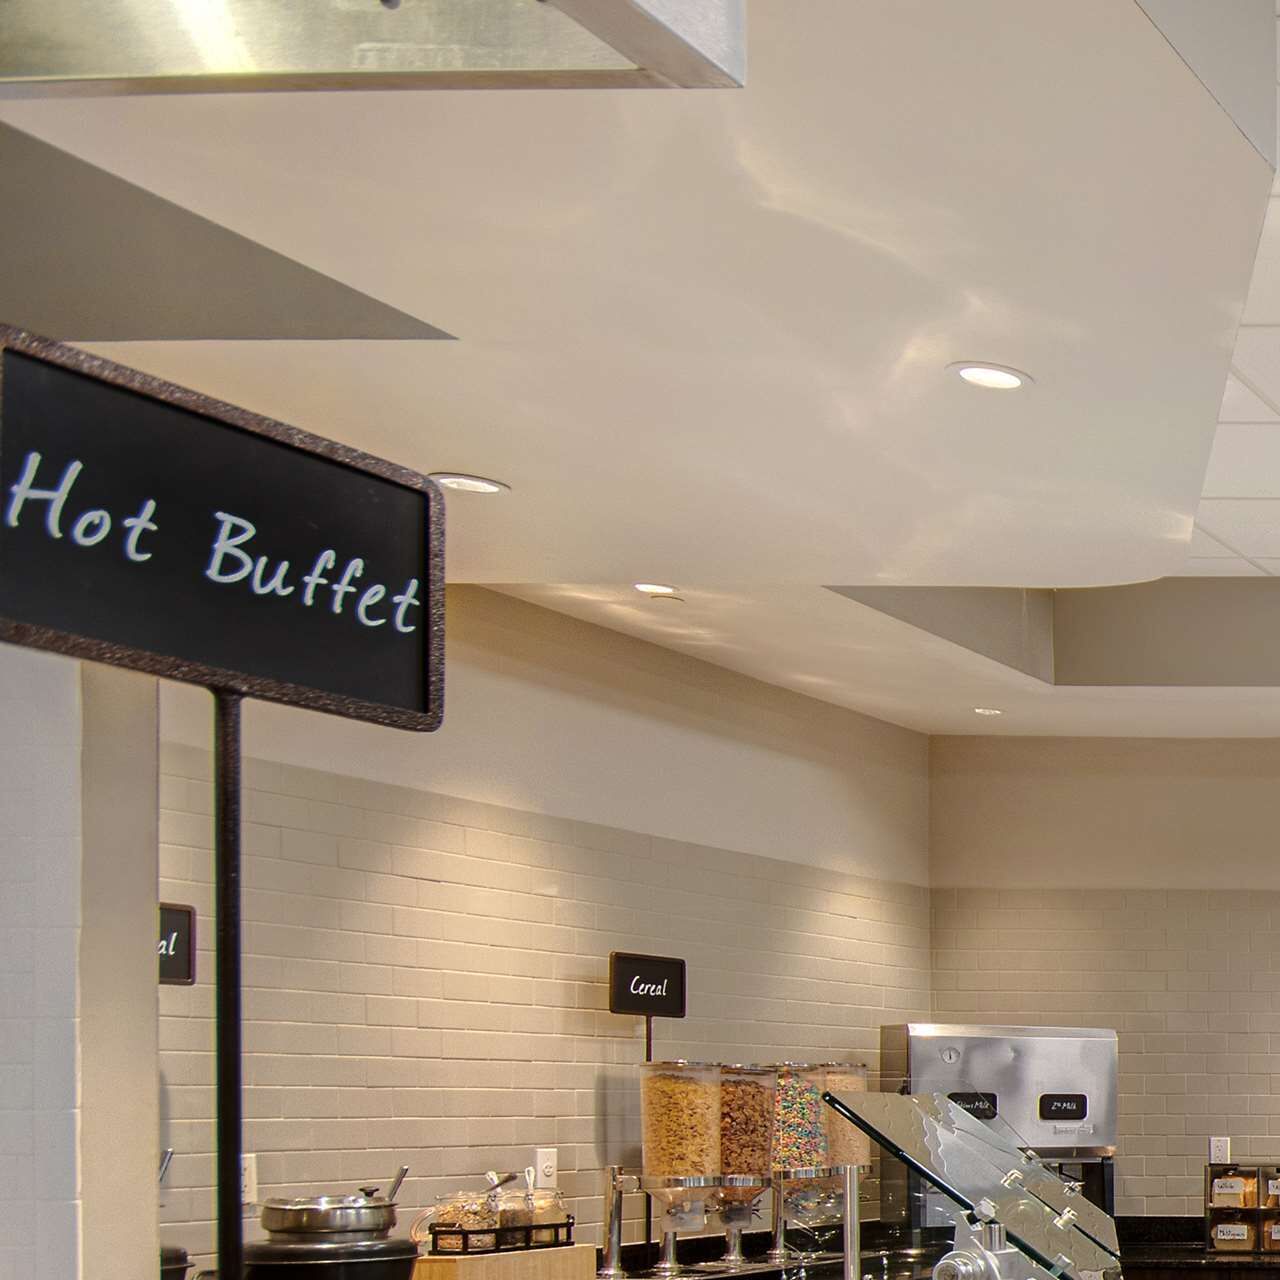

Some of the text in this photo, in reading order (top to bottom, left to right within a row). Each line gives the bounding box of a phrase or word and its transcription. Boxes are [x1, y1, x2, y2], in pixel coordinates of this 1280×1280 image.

[7, 452, 421, 633] Hot Buffet
[630, 975, 668, 996] Cereal
